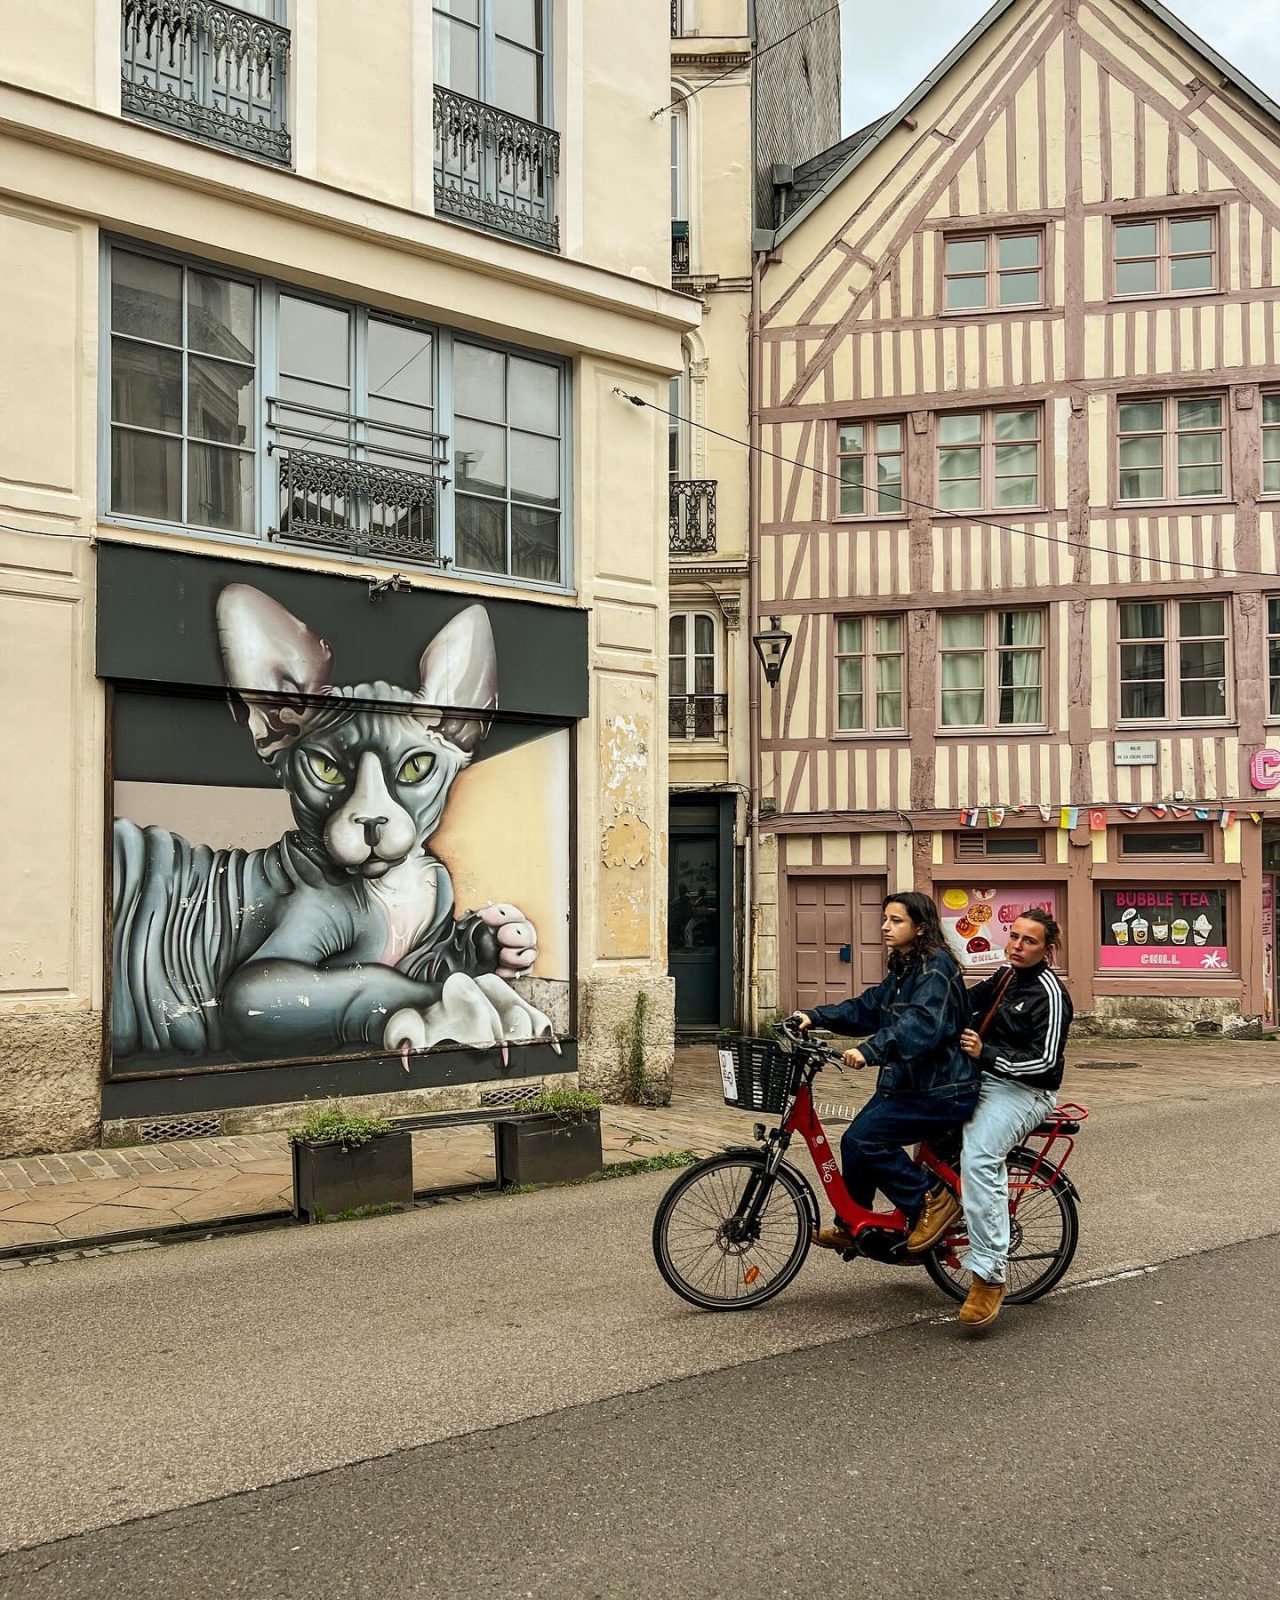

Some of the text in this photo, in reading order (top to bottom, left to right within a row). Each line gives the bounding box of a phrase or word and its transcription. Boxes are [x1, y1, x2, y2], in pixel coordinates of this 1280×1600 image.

[1115, 891, 1210, 907] BUBBLE TEA
[971, 953, 1000, 963] CHILL
[1140, 953, 1181, 965] CHILL
